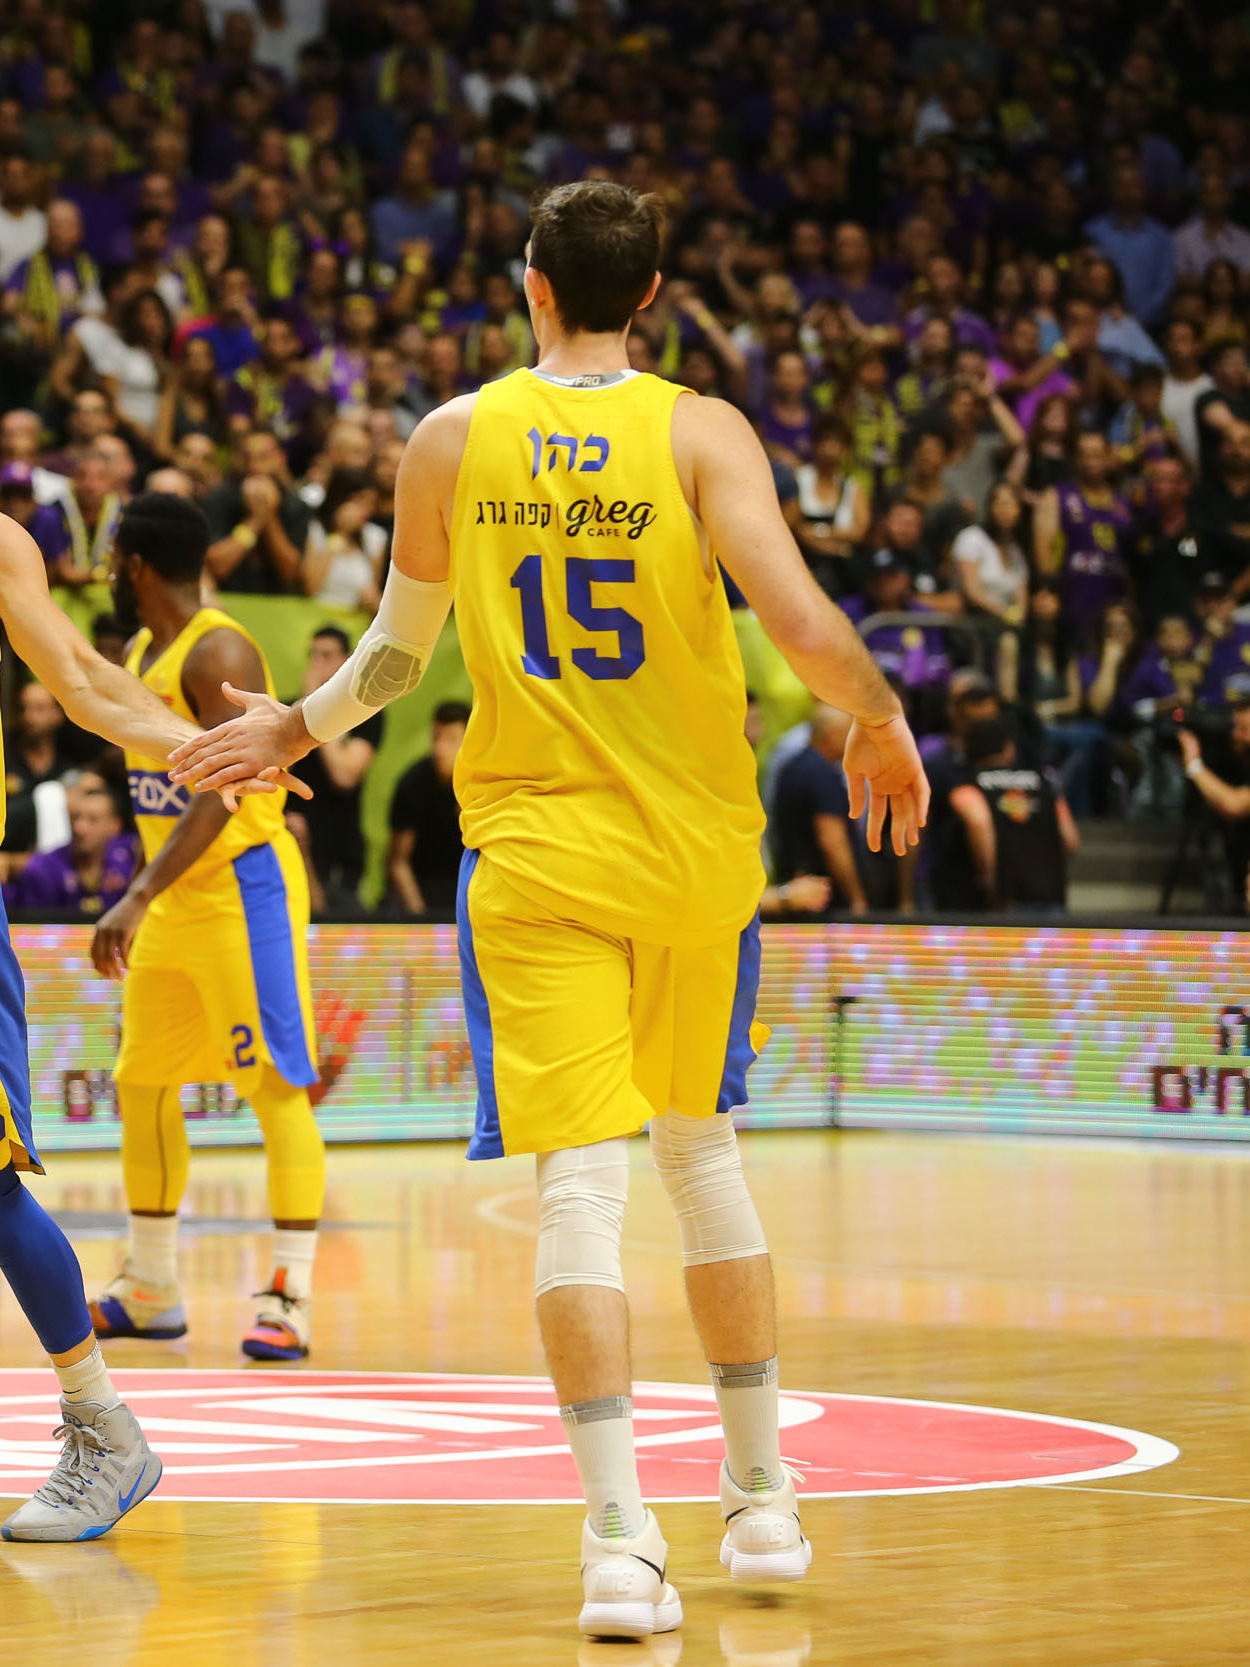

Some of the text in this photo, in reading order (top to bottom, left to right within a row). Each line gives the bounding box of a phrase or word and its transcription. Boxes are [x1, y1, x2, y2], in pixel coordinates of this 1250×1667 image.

[527, 427, 610, 480] כהן
[476, 501, 551, 528] קפה גרג
[566, 494, 657, 539] greg
[587, 528, 620, 537] CAFE
[510, 554, 645, 680] 15
[231, 1025, 255, 1067] 2
